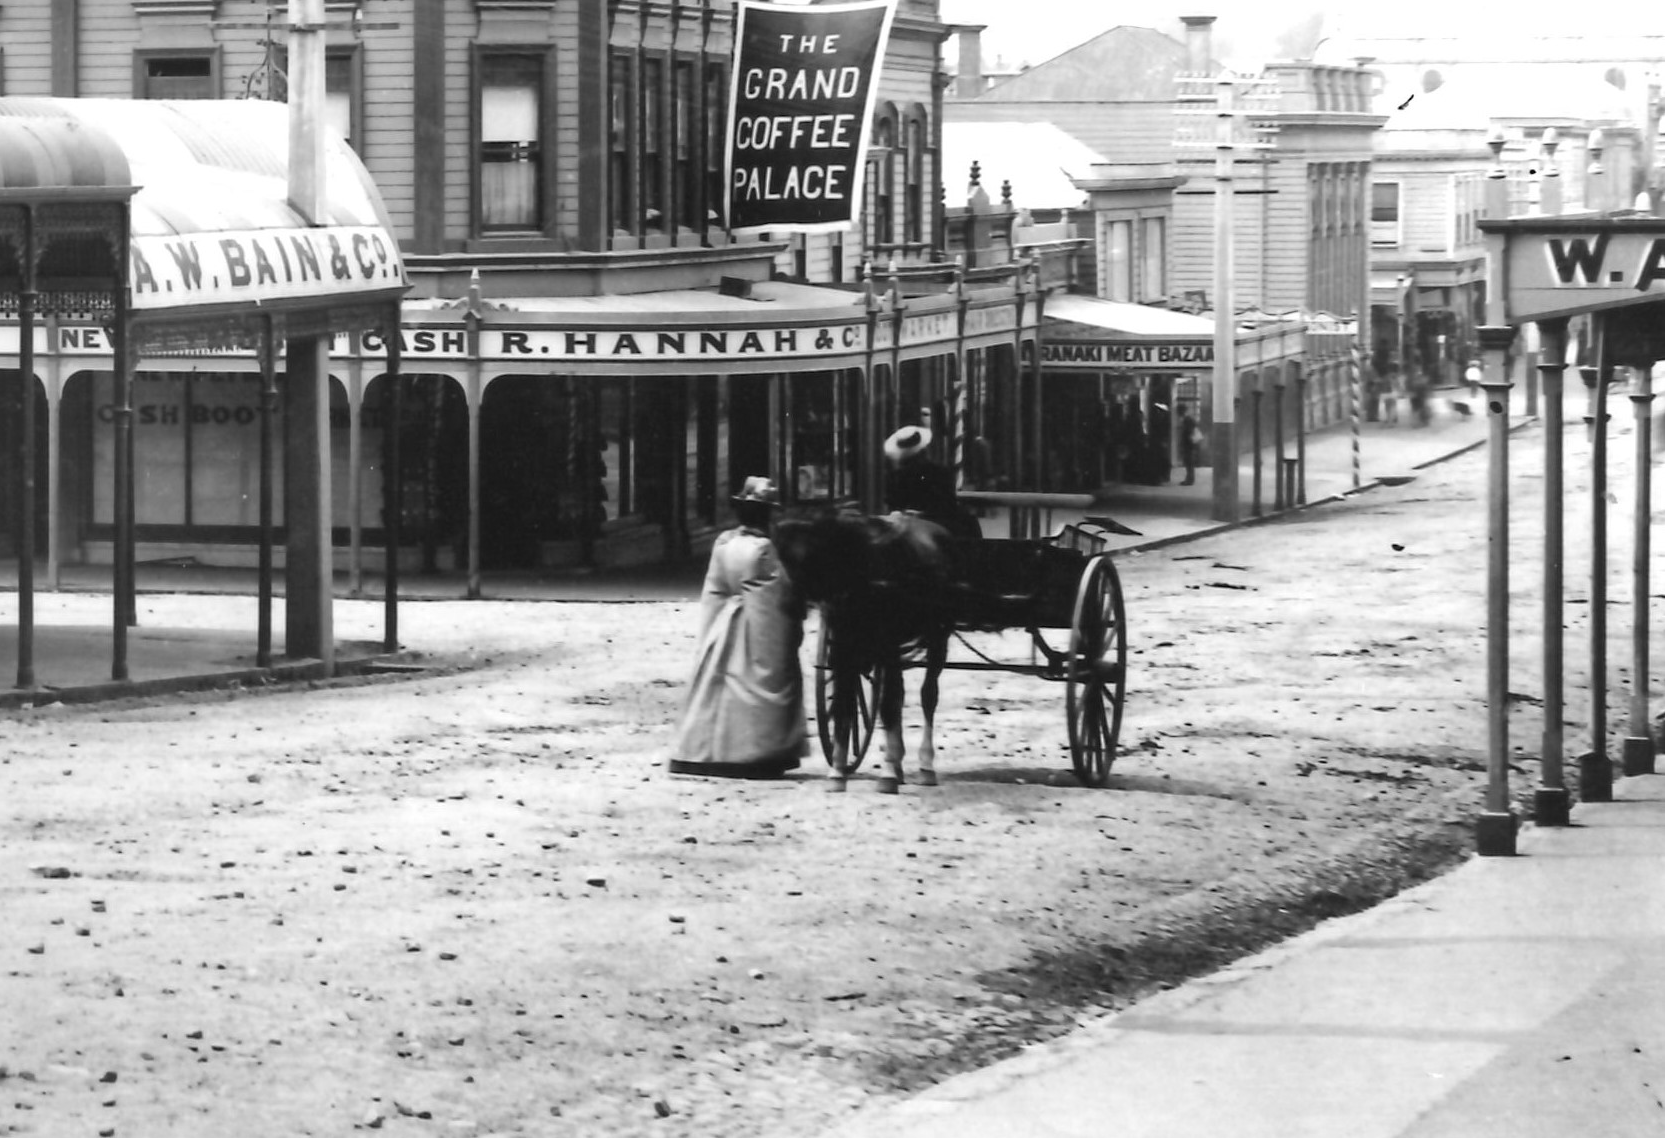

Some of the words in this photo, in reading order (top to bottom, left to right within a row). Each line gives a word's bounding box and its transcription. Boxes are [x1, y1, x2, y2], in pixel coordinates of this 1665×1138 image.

[779, 34, 841, 54] THE
[744, 66, 861, 101] GRAND
[736, 114, 855, 150] COFFEE
[734, 165, 846, 202] PALACE
[500, 331, 549, 354] R.
[564, 328, 798, 355] HANNAH
[815, 328, 834, 350] &
[1106, 345, 1153, 362] MEAT
[1158, 344, 1214, 362] BAZAA
[97, 403, 179, 425] CSH
